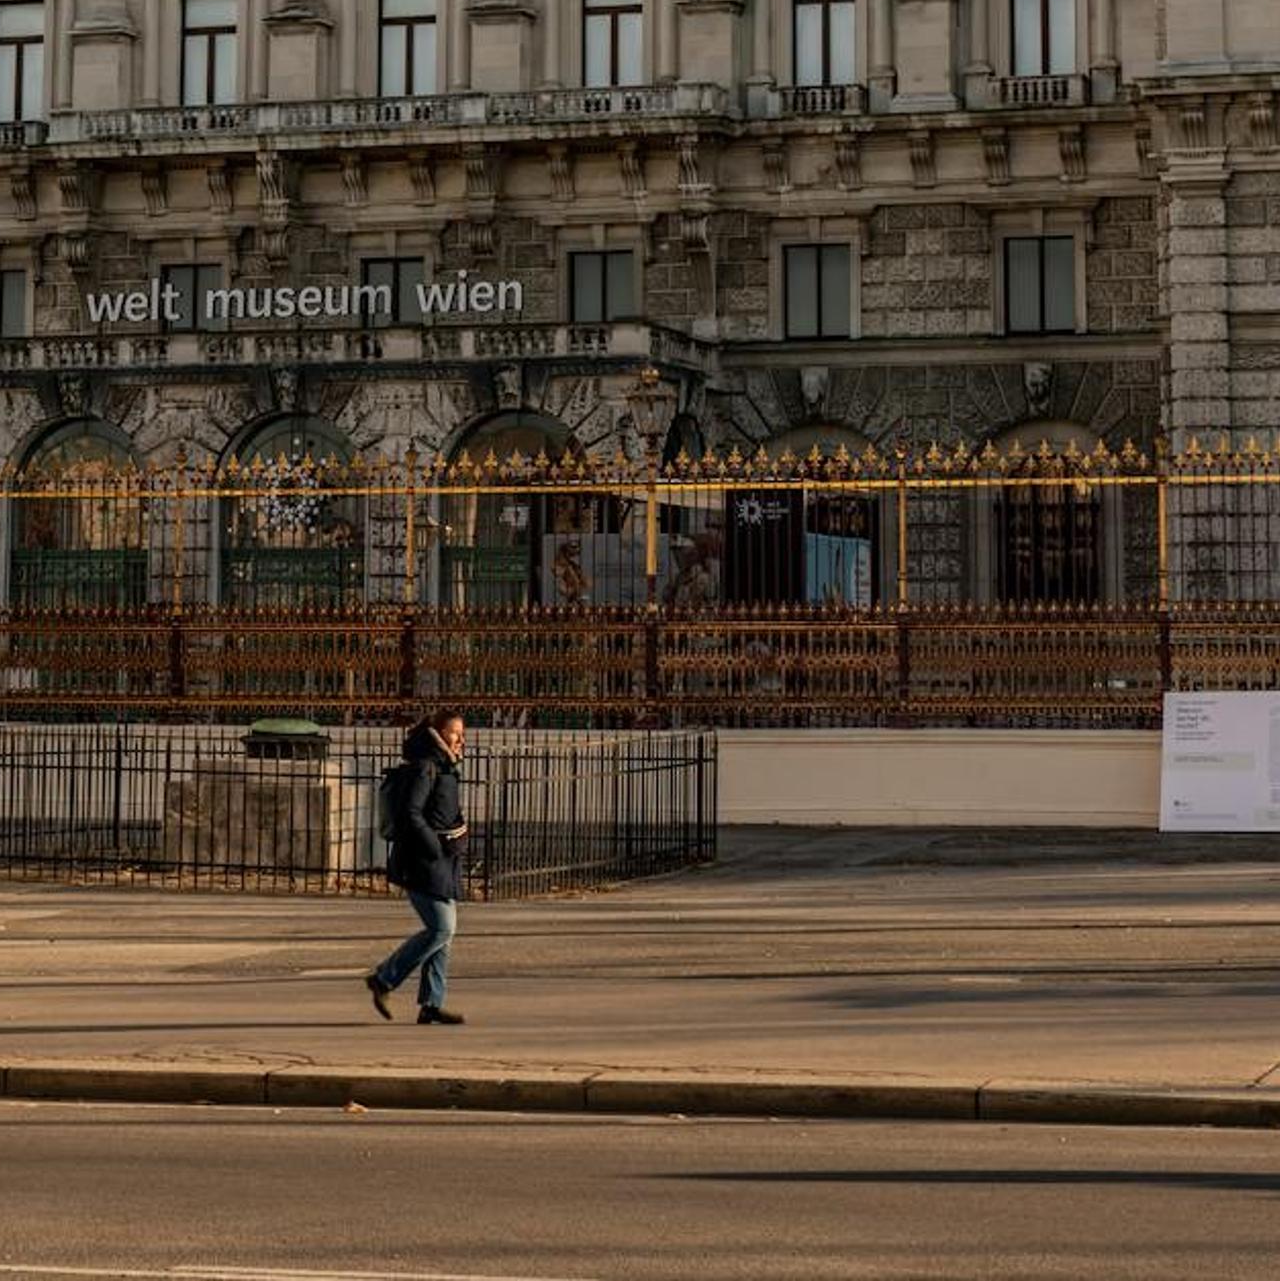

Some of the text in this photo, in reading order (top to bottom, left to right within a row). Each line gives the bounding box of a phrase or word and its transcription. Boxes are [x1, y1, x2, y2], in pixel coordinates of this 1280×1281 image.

[86, 269, 522, 322] welt museum wien
